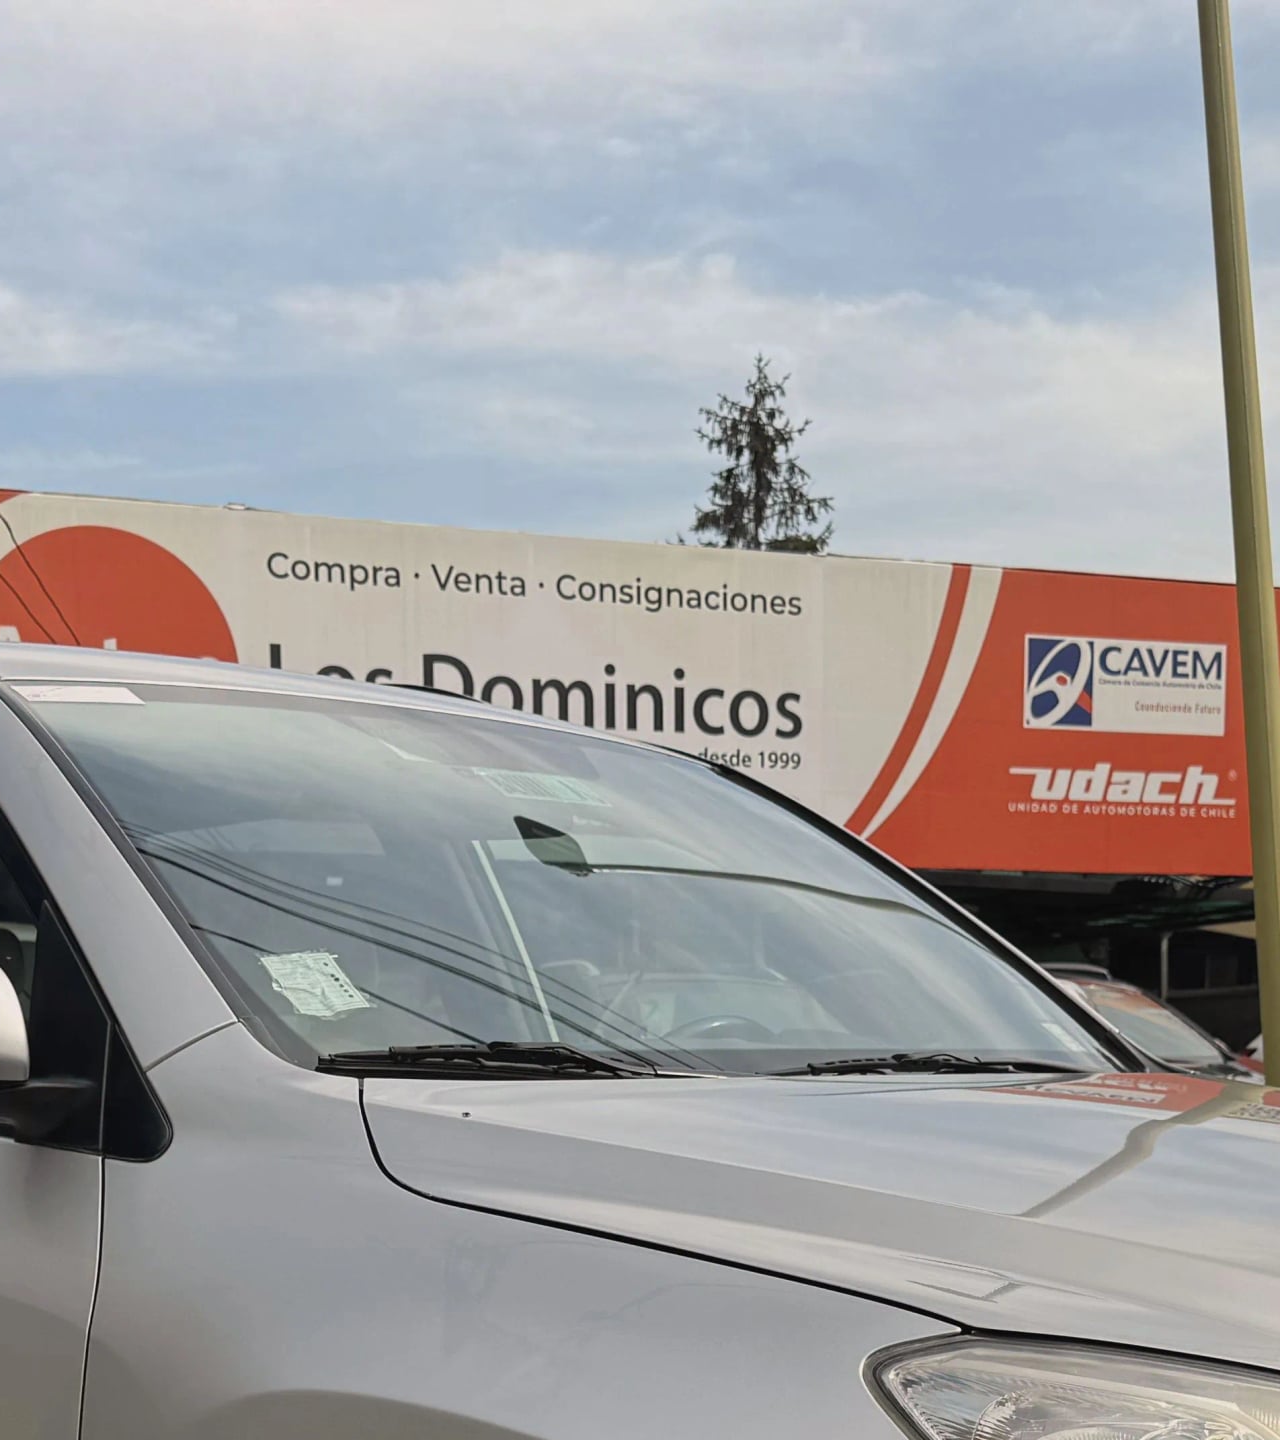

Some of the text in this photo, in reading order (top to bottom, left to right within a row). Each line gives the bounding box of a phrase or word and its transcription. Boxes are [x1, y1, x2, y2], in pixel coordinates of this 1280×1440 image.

[266, 552, 802, 616] Compra Venta Consignaciones
[1098, 646, 1223, 680] CAVEM
[757, 751, 801, 770] 1999
[1009, 762, 1236, 806] udach
[1008, 802, 1236, 819] UNIDAD DE AUTOMOTORAS DE CHILE
